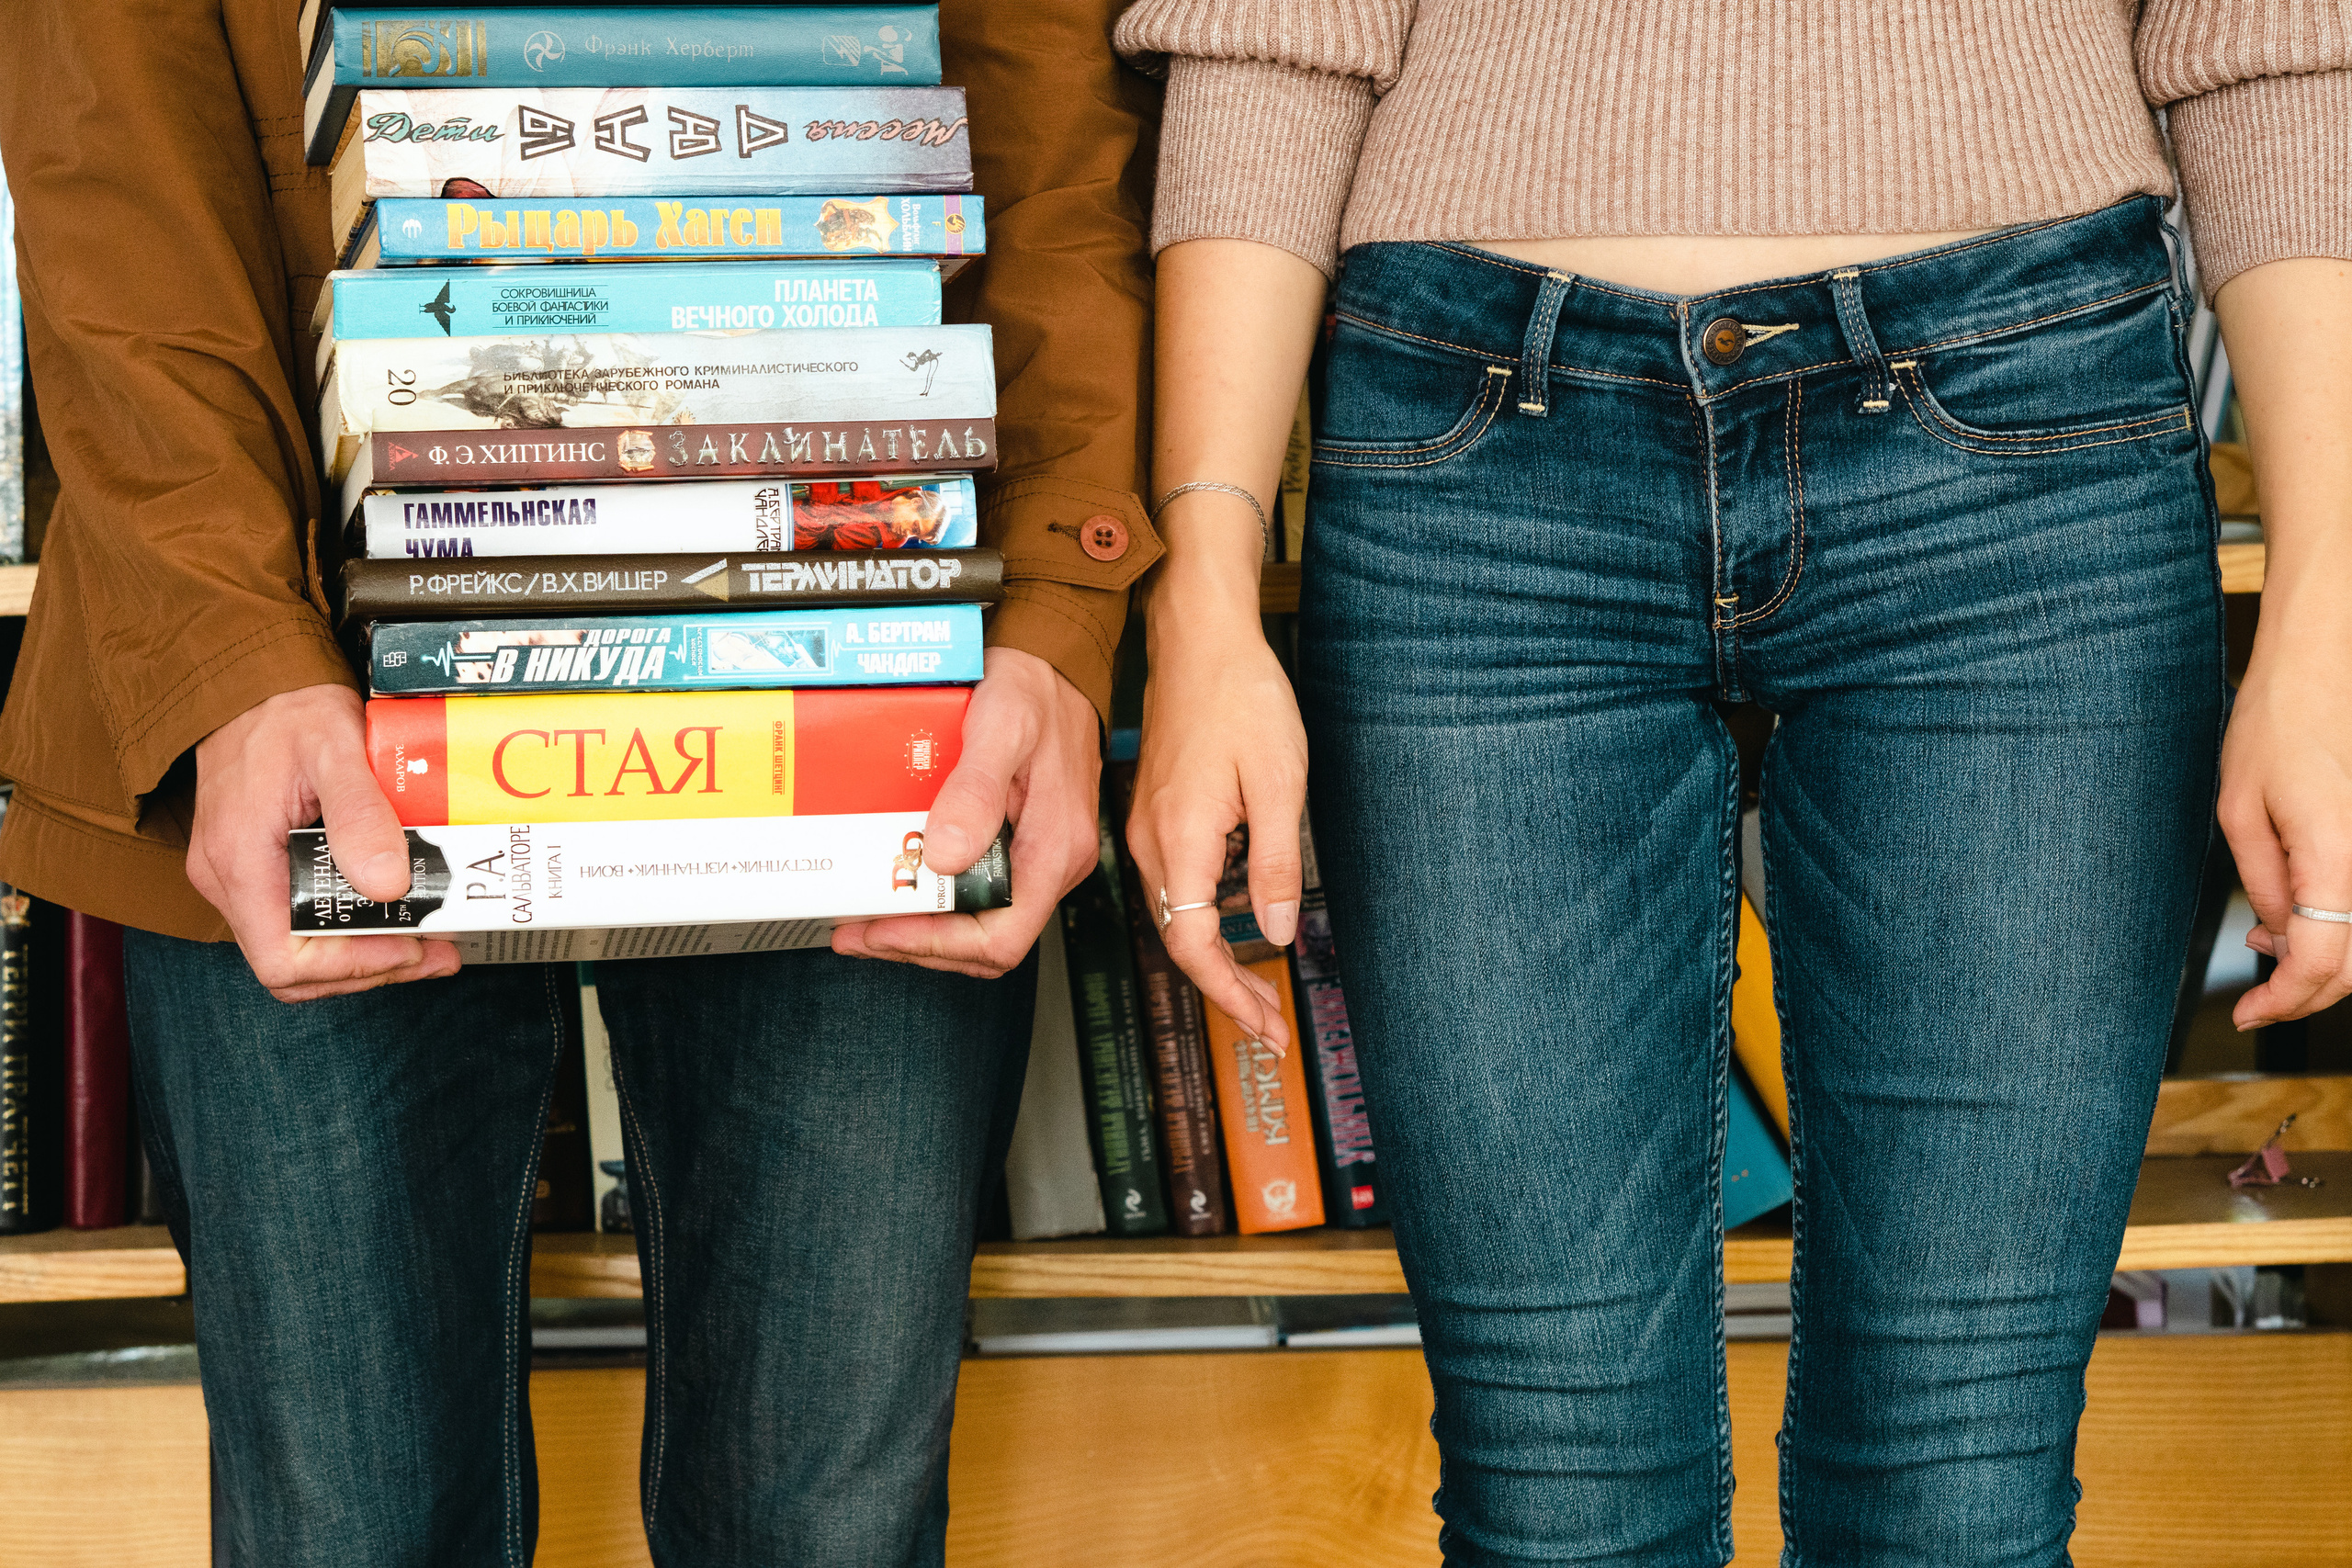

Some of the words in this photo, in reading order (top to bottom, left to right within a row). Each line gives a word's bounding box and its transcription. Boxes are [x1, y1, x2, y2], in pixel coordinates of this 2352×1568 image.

[585, 34, 651, 61] Фрэнк
[666, 37, 754, 62] Херберт
[364, 111, 505, 142] Дети
[447, 203, 639, 254] Рыцарь
[655, 201, 783, 249] Хаген
[900, 197, 912, 252] ХОЛЬБАЙН
[501, 288, 596, 299] СОКРОВИЩНИЦА
[775, 278, 879, 302] ПЛАНЕТА
[492, 301, 537, 312] БОЕВОЙ
[540, 300, 609, 312] ФАНТАСТИКИ
[505, 316, 514, 325] И
[517, 313, 596, 325] ПРИКЛЮЧЕНИЙ
[672, 305, 775, 329] ВЕЧНОГО
[782, 304, 879, 328] ХОЛОДА
[387, 368, 417, 406] 20
[504, 368, 589, 381] БИБЛИОТЕКА
[594, 366, 689, 379] ЗАРУБЕЖНОГО
[695, 362, 858, 376] КРИМИНАЛИСТИЧЕСКОГО
[504, 385, 514, 394] И
[517, 381, 659, 394] ПРИКЛЮЧЕНЧЕСКОГО
[666, 379, 720, 389] РОМАНА
[428, 446, 450, 465] Ф.
[456, 445, 476, 465] Э.
[481, 442, 605, 464] ХИГГИНС
[668, 424, 988, 467] ЗАКЛИНАТЕЛЬ
[403, 498, 597, 529] ГАММЕЛЬНСКАЯ
[754, 489, 769, 551] ЧАНДЛЕ
[767, 488, 781, 551] А.БЕРТРА
[405, 537, 473, 558] ЧУМА
[741, 558, 962, 592] ТЕРМИНАТОР
[582, 628, 672, 648] ДОРОГА
[845, 623, 865, 643] А.
[868, 619, 950, 643] БЕРТРАМ
[490, 649, 519, 683] В
[523, 646, 667, 686] НИКУДА
[857, 652, 942, 677] ЧАНДЛЕР
[775, 720, 783, 752] ФРАНК
[395, 744, 405, 793] ЗАХАРОВ
[492, 726, 723, 798] СТАЯ
[774, 755, 783, 795] ШЕТЦИНГ
[510, 825, 532, 923] САЛЬВАТОРЕ
[548, 852, 562, 899] КНИГА
[580, 864, 624, 878] ВОИН
[635, 862, 729, 876] ИЗГНАННИК
[738, 858, 832, 873] ОТСТУПНИК
[336, 866, 354, 913] ТЕМ
